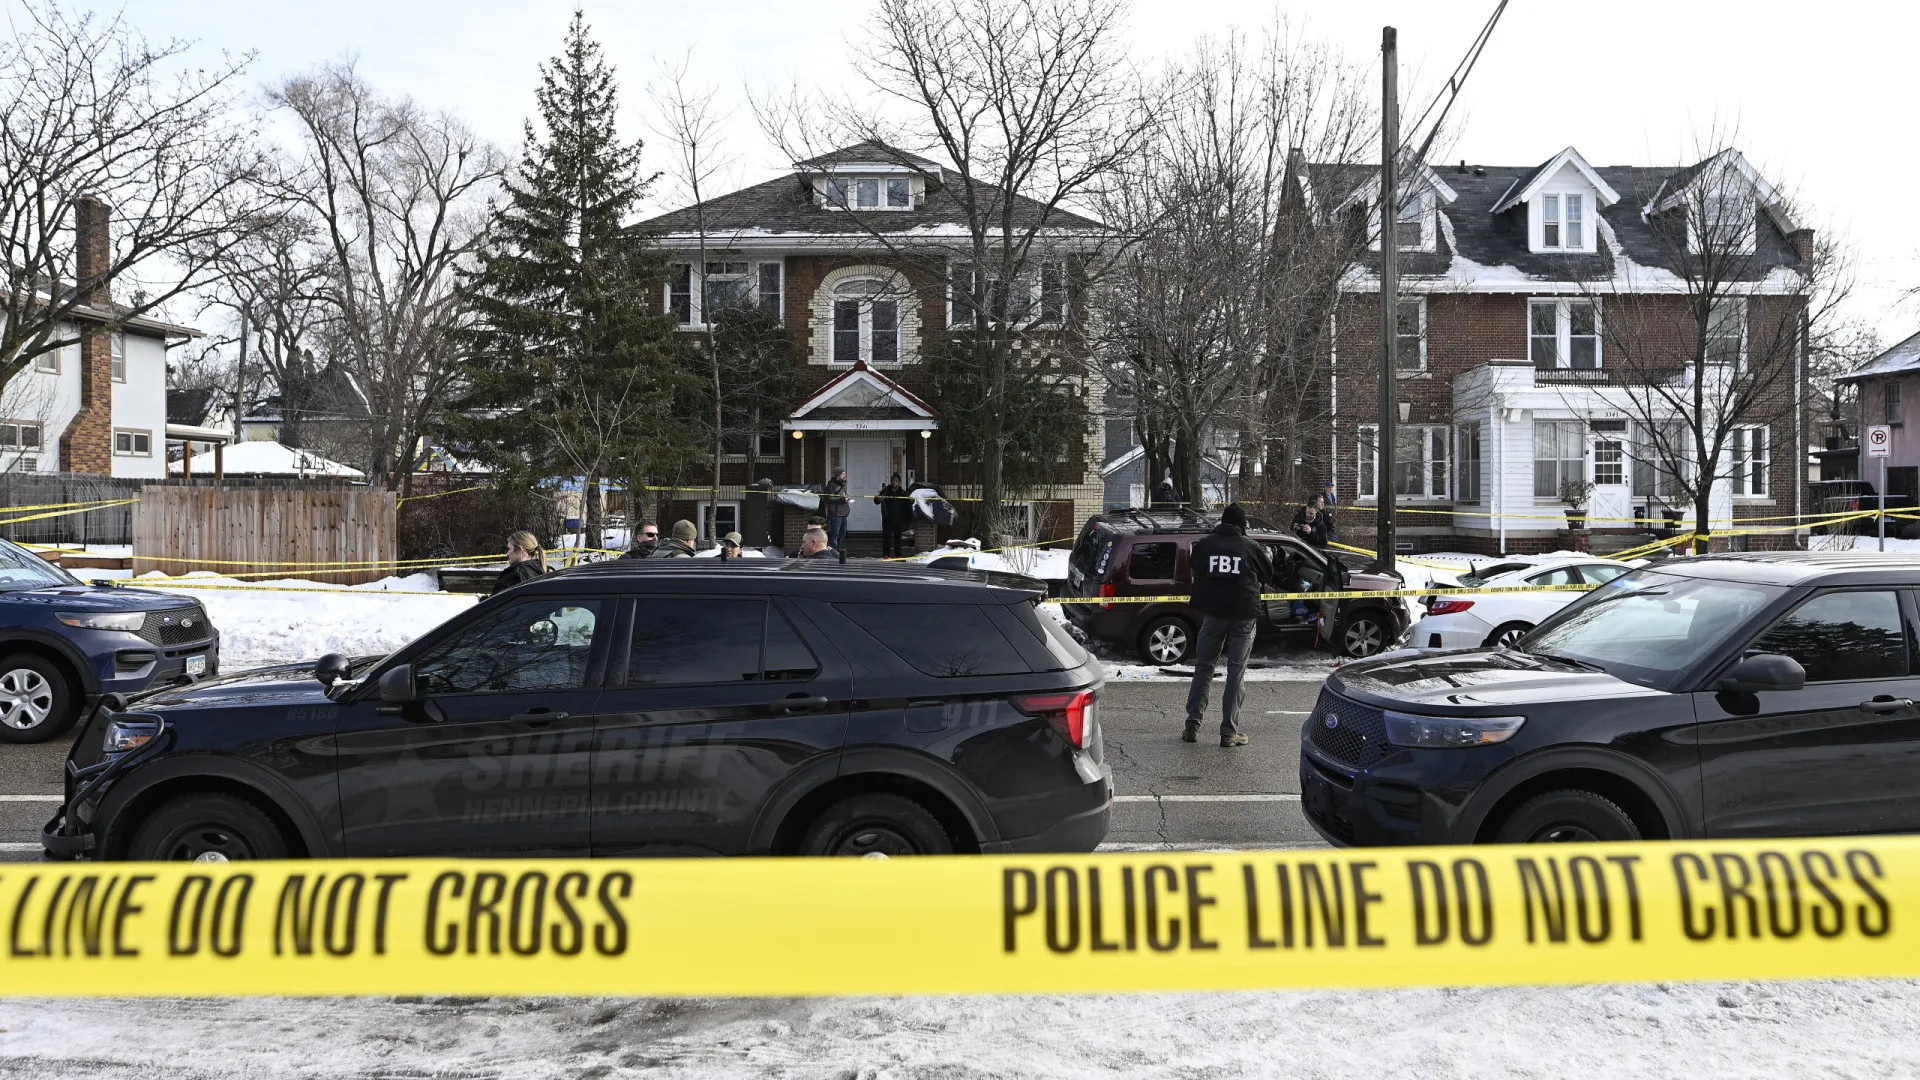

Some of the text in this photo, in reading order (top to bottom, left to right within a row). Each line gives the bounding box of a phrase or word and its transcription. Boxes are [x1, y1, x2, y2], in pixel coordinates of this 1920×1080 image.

[1209, 555, 1242, 575] FBI
[941, 698, 999, 728] 911
[460, 721, 747, 791] SHERIFF
[462, 786, 733, 824] HENNEPIN COUNTY
[10, 870, 635, 959] LINE DO NOT CROSS
[1003, 849, 1892, 954] POLICE LINE DO NOT CROSS
